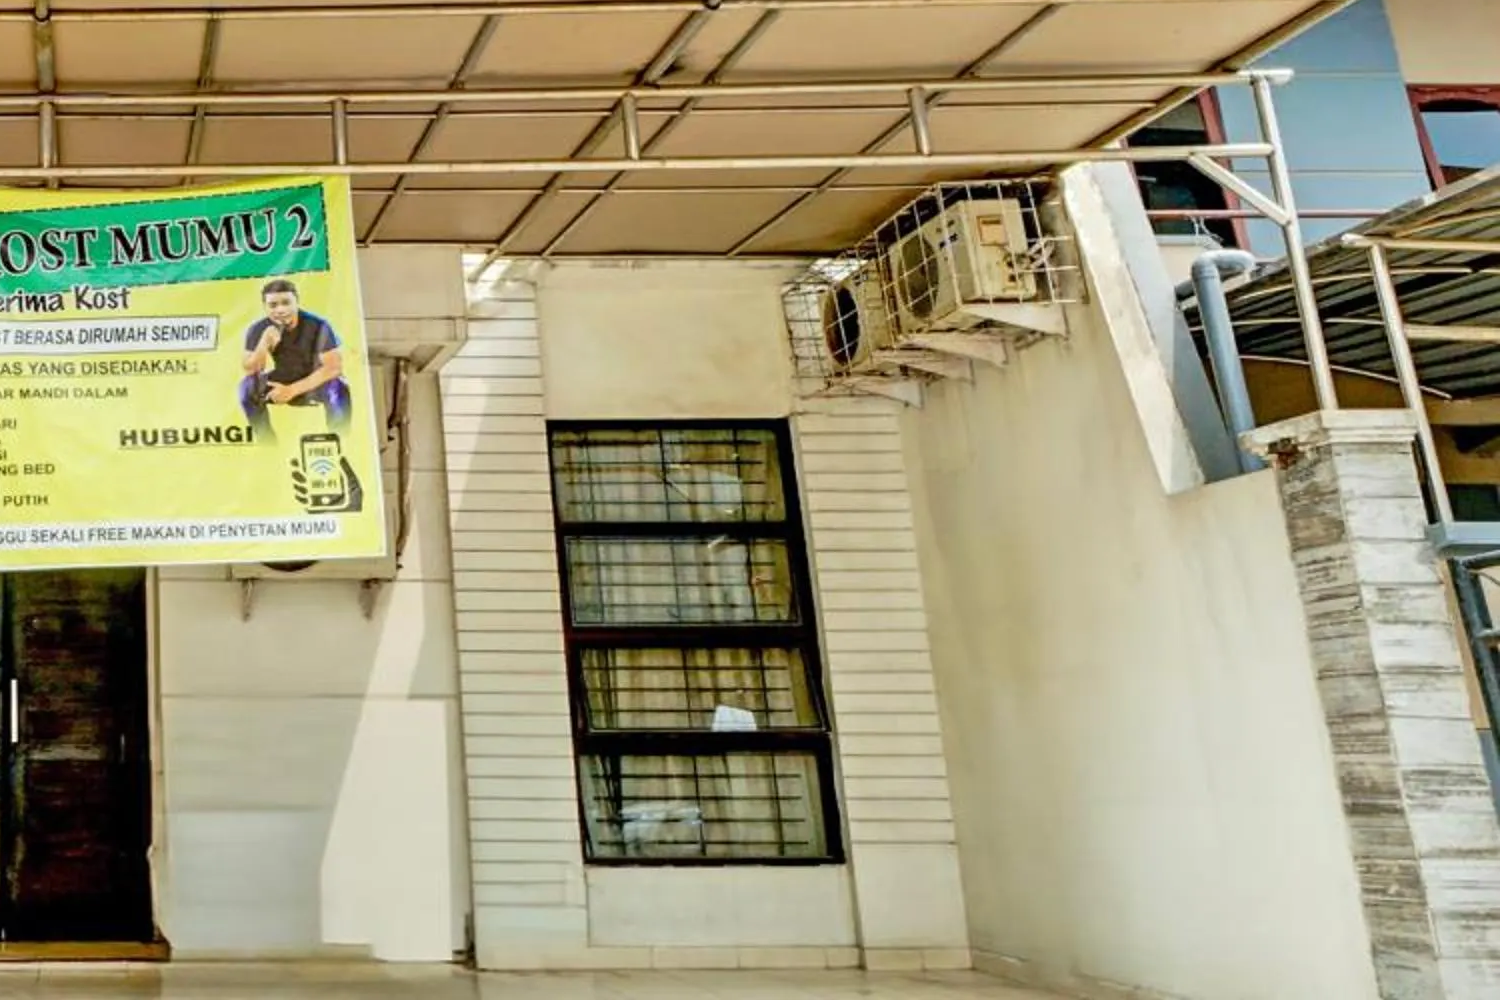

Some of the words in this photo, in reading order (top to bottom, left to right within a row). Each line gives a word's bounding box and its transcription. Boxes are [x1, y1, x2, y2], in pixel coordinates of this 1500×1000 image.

[108, 208, 275, 265] MUMU
[286, 204, 314, 248] 2
[74, 285, 131, 310] Kost
[14, 329, 75, 345] BERASA
[78, 326, 147, 345] DIRUMAH
[151, 324, 210, 342] SENDIRI
[28, 361, 76, 376] YANG
[80, 359, 188, 376] DISEDIAKAN
[18, 387, 69, 400] MANDI
[72, 386, 128, 399] DALAM
[119, 425, 253, 447] HUBUNGI
[23, 463, 56, 475] BED
[3, 494, 49, 507] PUTIH
[31, 528, 85, 544] SEKALI
[88, 527, 128, 542] FREE
[131, 526, 185, 541] MAKAN
[189, 525, 205, 539] DI
[209, 522, 287, 538] PENYETAN
[290, 519, 337, 535] MUMU
